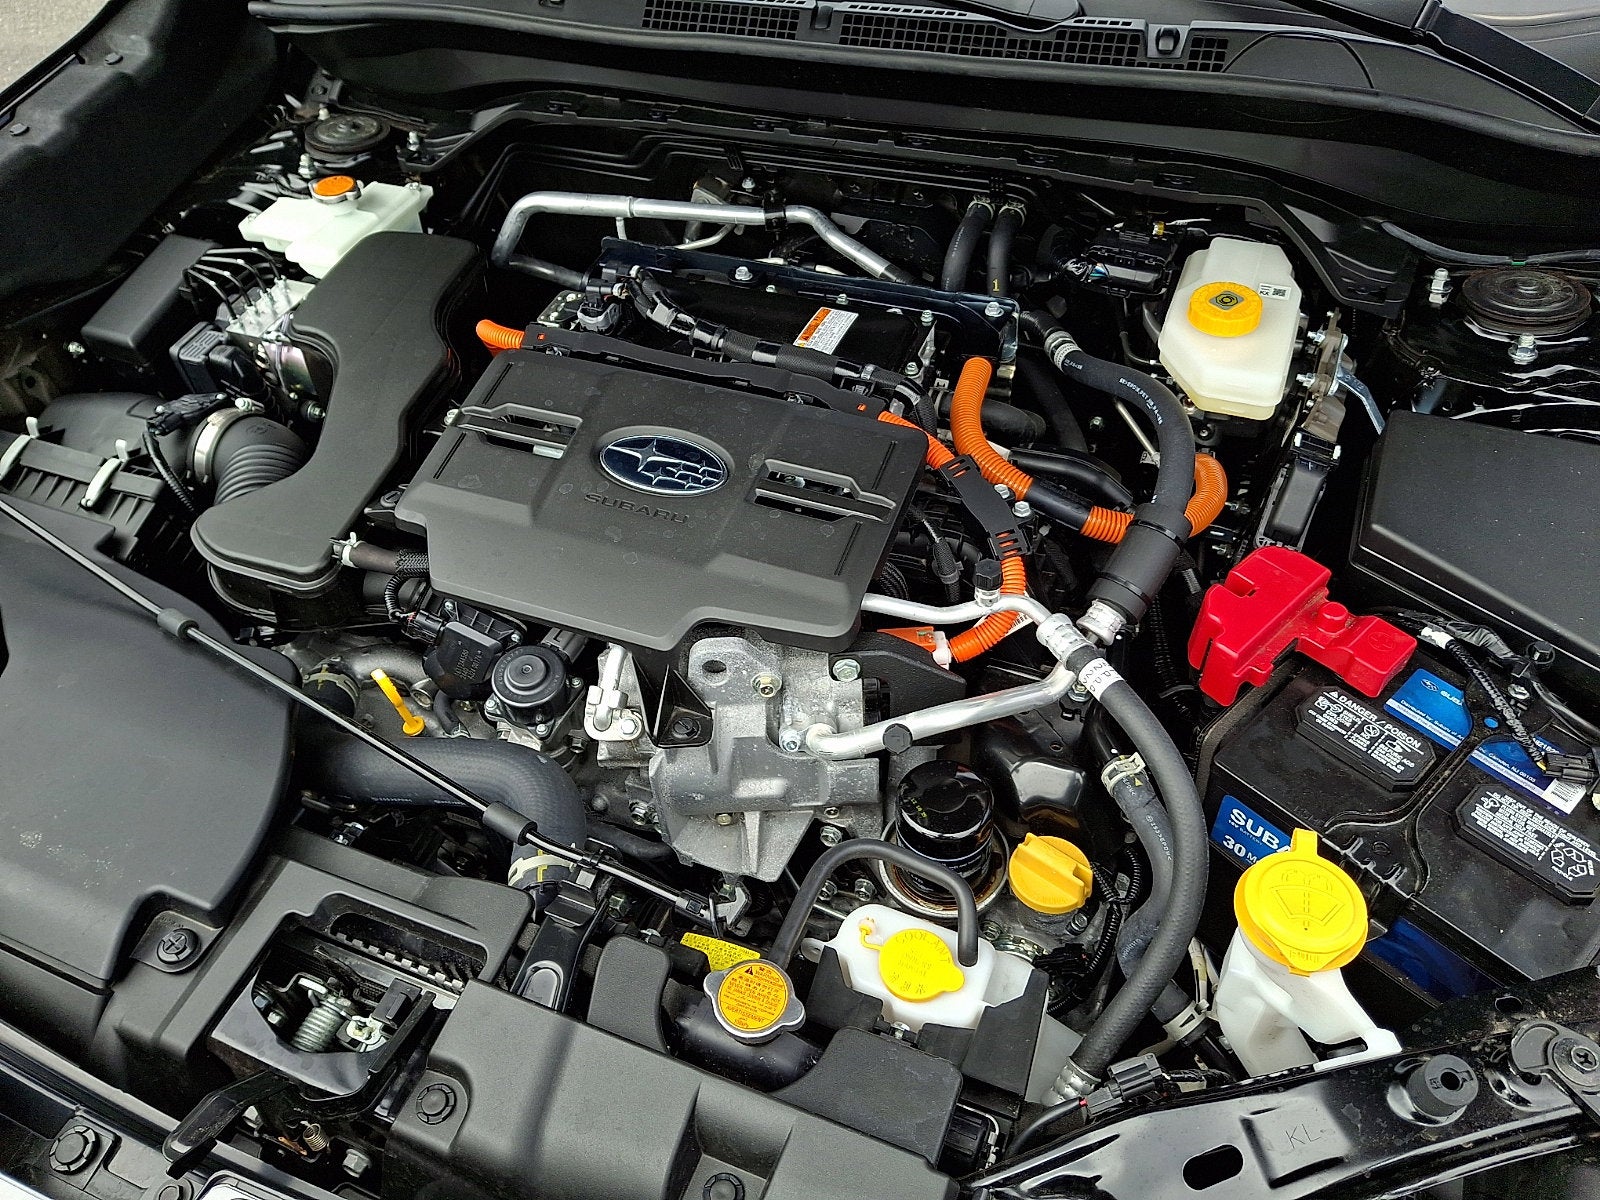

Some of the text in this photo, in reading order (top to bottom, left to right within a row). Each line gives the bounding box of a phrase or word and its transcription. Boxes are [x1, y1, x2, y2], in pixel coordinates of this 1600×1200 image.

[992, 278, 1000, 292] 1
[584, 492, 690, 523] SUBARU
[1338, 695, 1378, 722] DANGER
[1384, 723, 1422, 749] POISON
[1222, 834, 1246, 857] 30
